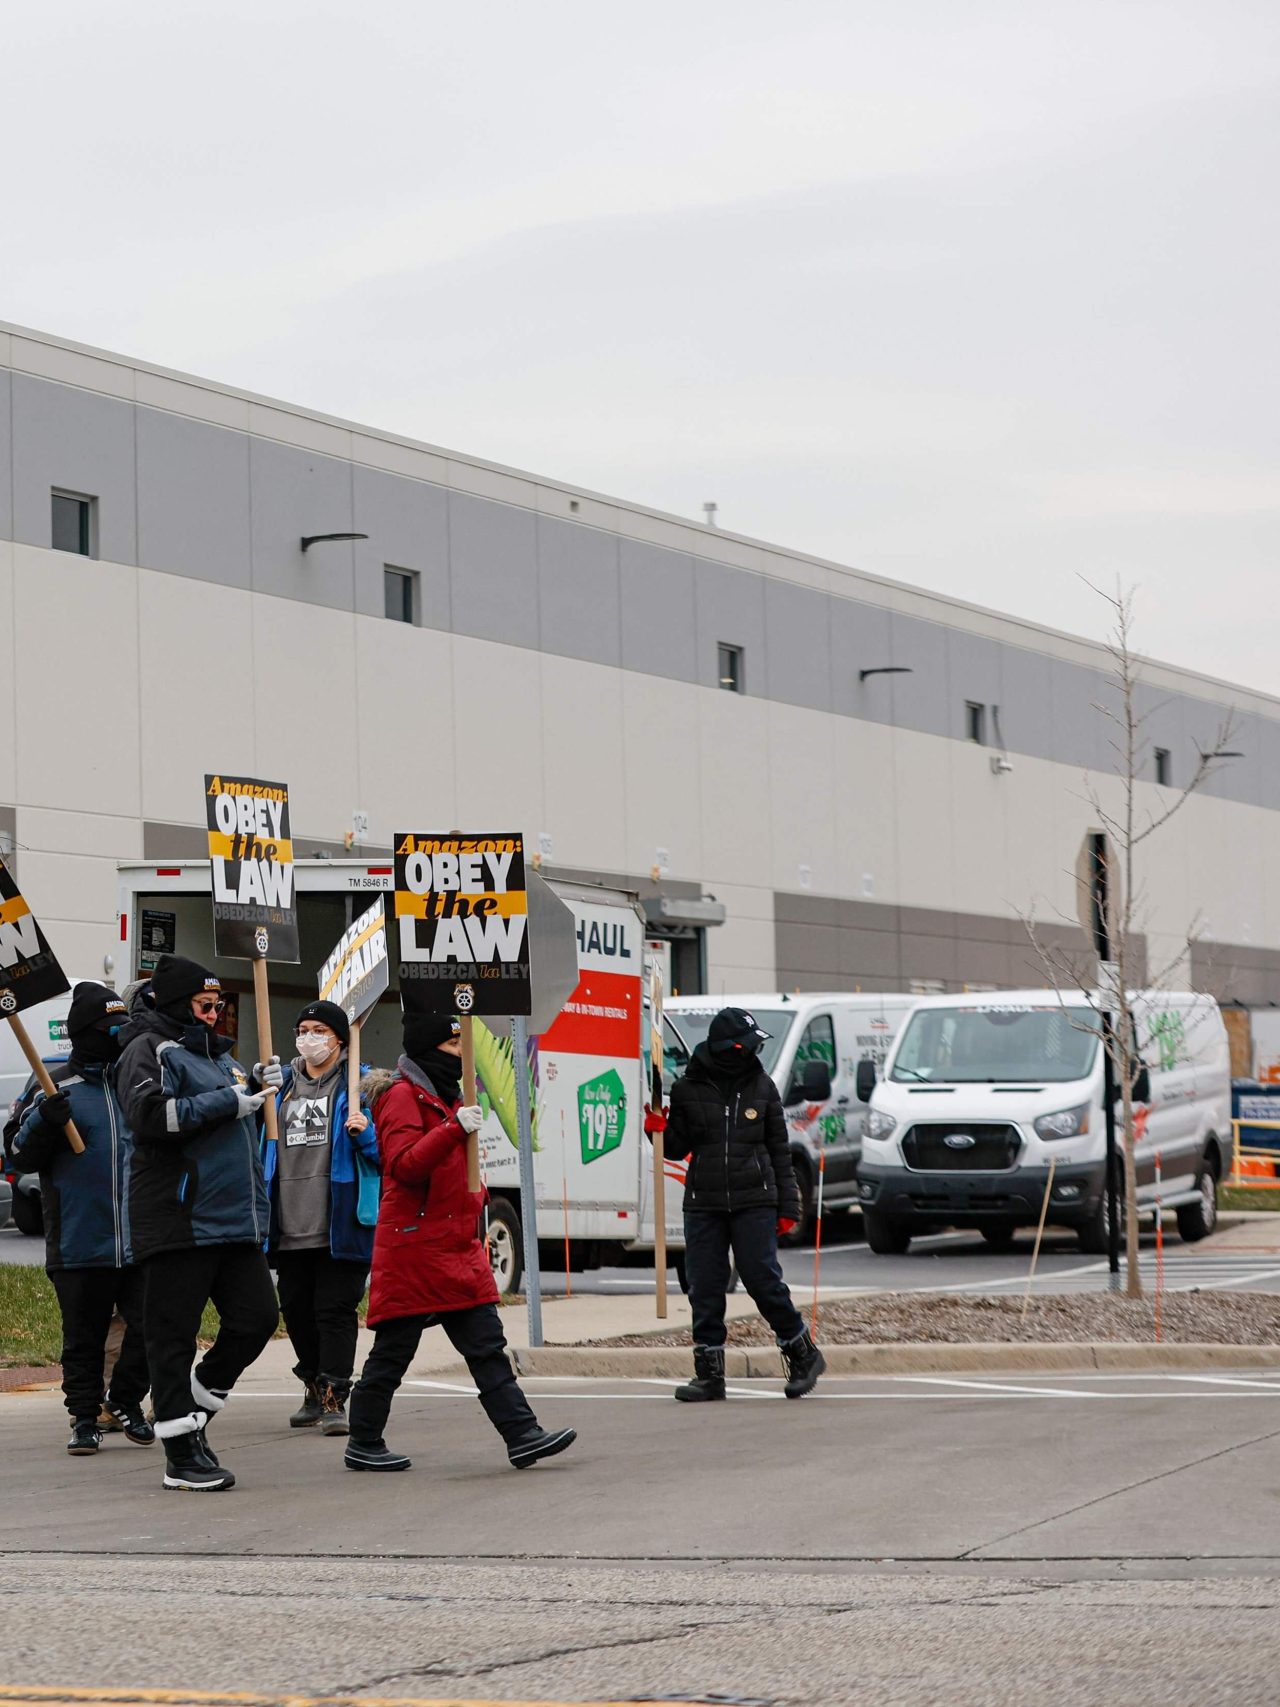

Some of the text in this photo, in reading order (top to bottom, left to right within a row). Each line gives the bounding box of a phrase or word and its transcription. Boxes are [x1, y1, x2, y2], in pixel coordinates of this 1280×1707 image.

[207, 776, 288, 803] Amazon:
[215, 793, 284, 841] OBEY
[229, 832, 278, 862] the
[395, 834, 523, 855] Amazon:
[212, 855, 295, 909] LAW
[348, 878, 389, 888] TM 5846 R
[404, 851, 515, 896] OBEY
[422, 890, 498, 919] the
[321, 900, 381, 994] AMAZON
[399, 914, 527, 963] LAW
[399, 963, 479, 980] OBEDEZCA
[501, 963, 530, 980] LEY
[294, 1133, 325, 1141] Columbia
